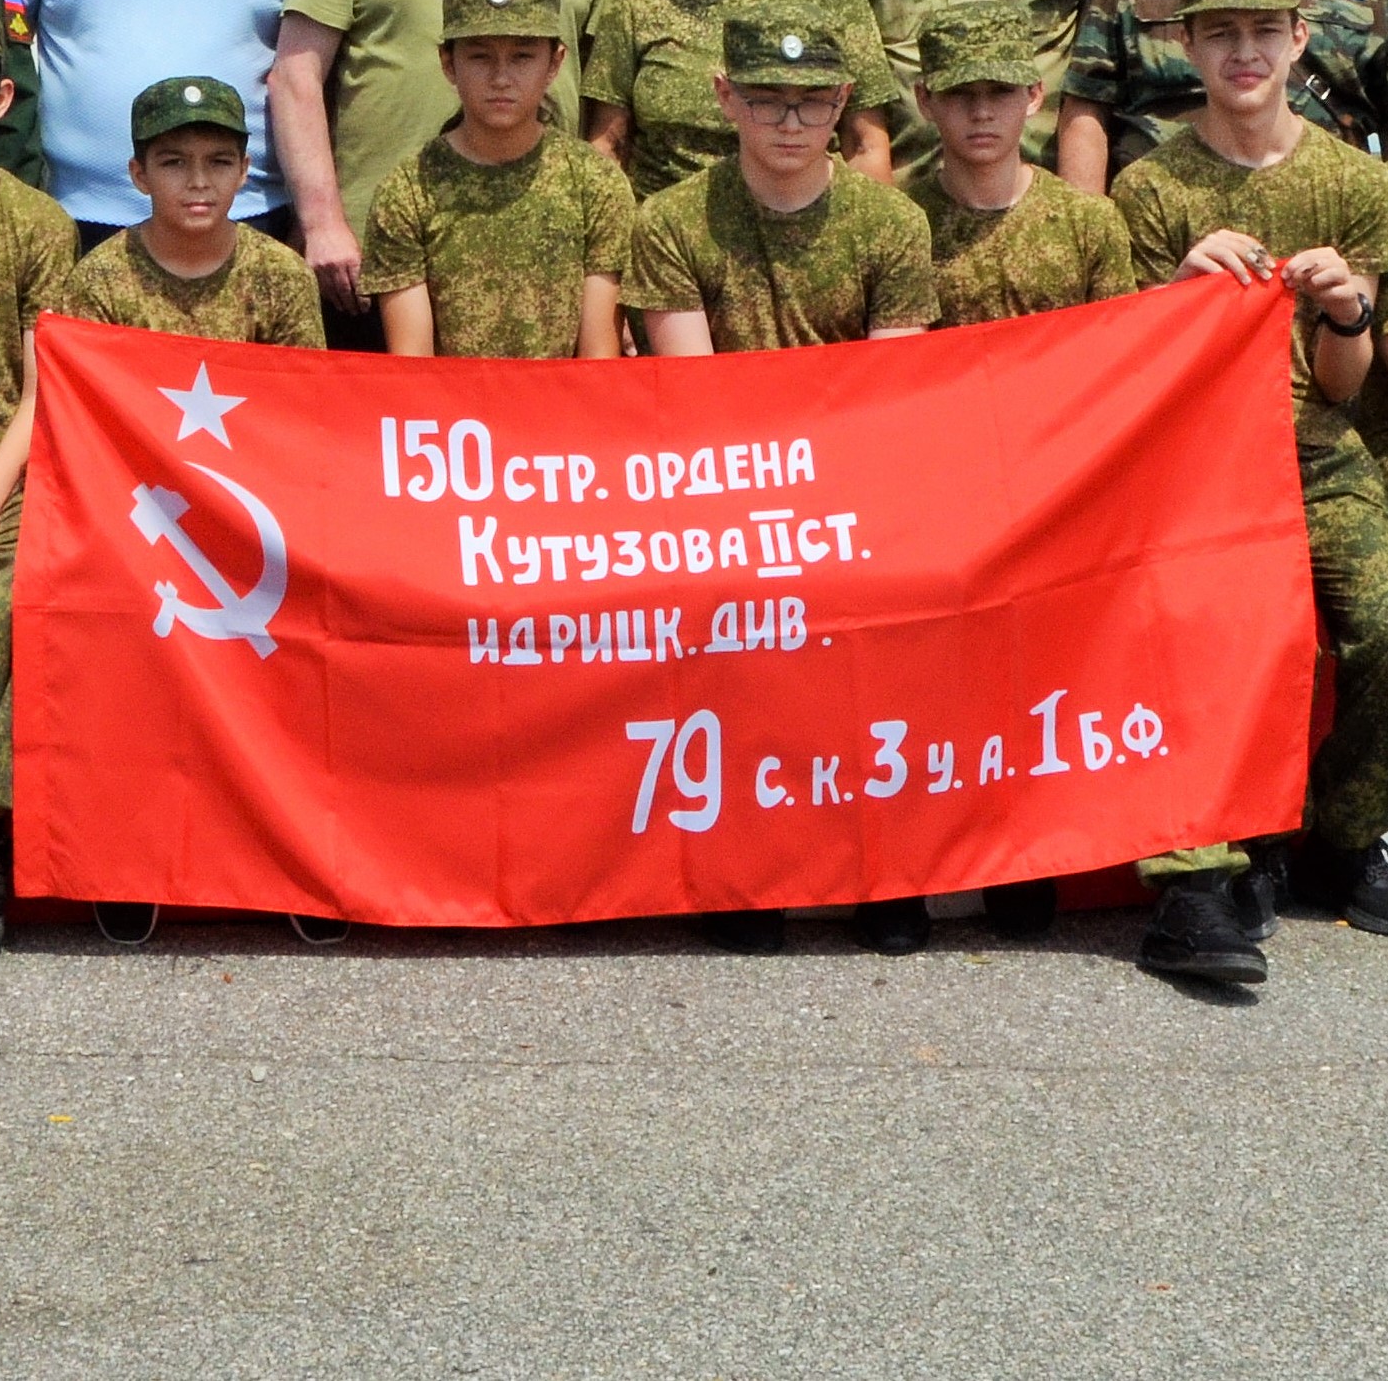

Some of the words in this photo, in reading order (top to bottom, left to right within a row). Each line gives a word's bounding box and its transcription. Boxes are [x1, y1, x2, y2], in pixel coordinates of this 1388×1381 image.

[381, 416, 495, 503] 150
[624, 438, 816, 502] ОРДЕНА
[625, 708, 722, 835] 79
[863, 719, 908, 799] 3
[1028, 688, 1069, 777] 1
